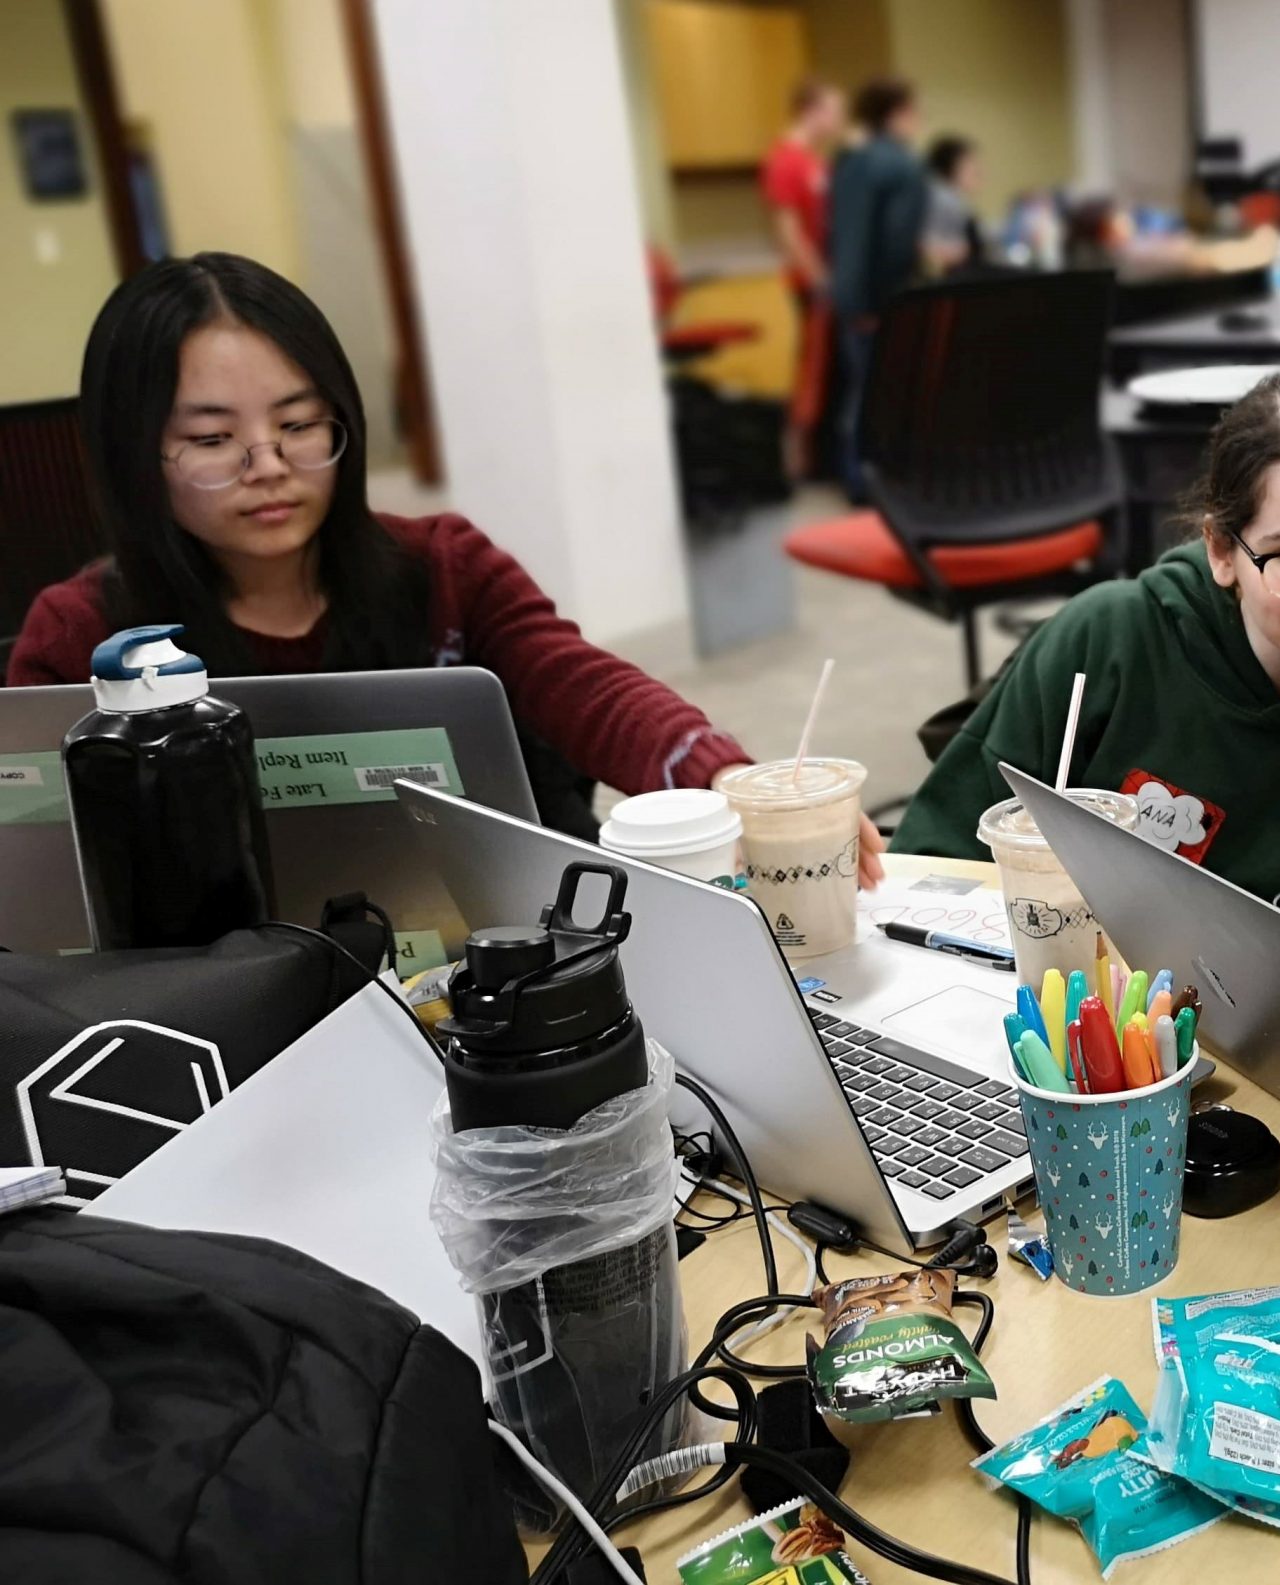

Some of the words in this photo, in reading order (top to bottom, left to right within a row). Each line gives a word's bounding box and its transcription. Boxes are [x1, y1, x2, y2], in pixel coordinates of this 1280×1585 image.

[305, 751, 348, 766] Item
[300, 783, 328, 797] Late
[833, 1334, 955, 1369] ALMONDS
[840, 1333, 894, 1354] roasted
[1120, 1463, 1148, 1480] ACKS
[1118, 1468, 1166, 1498] UITY
